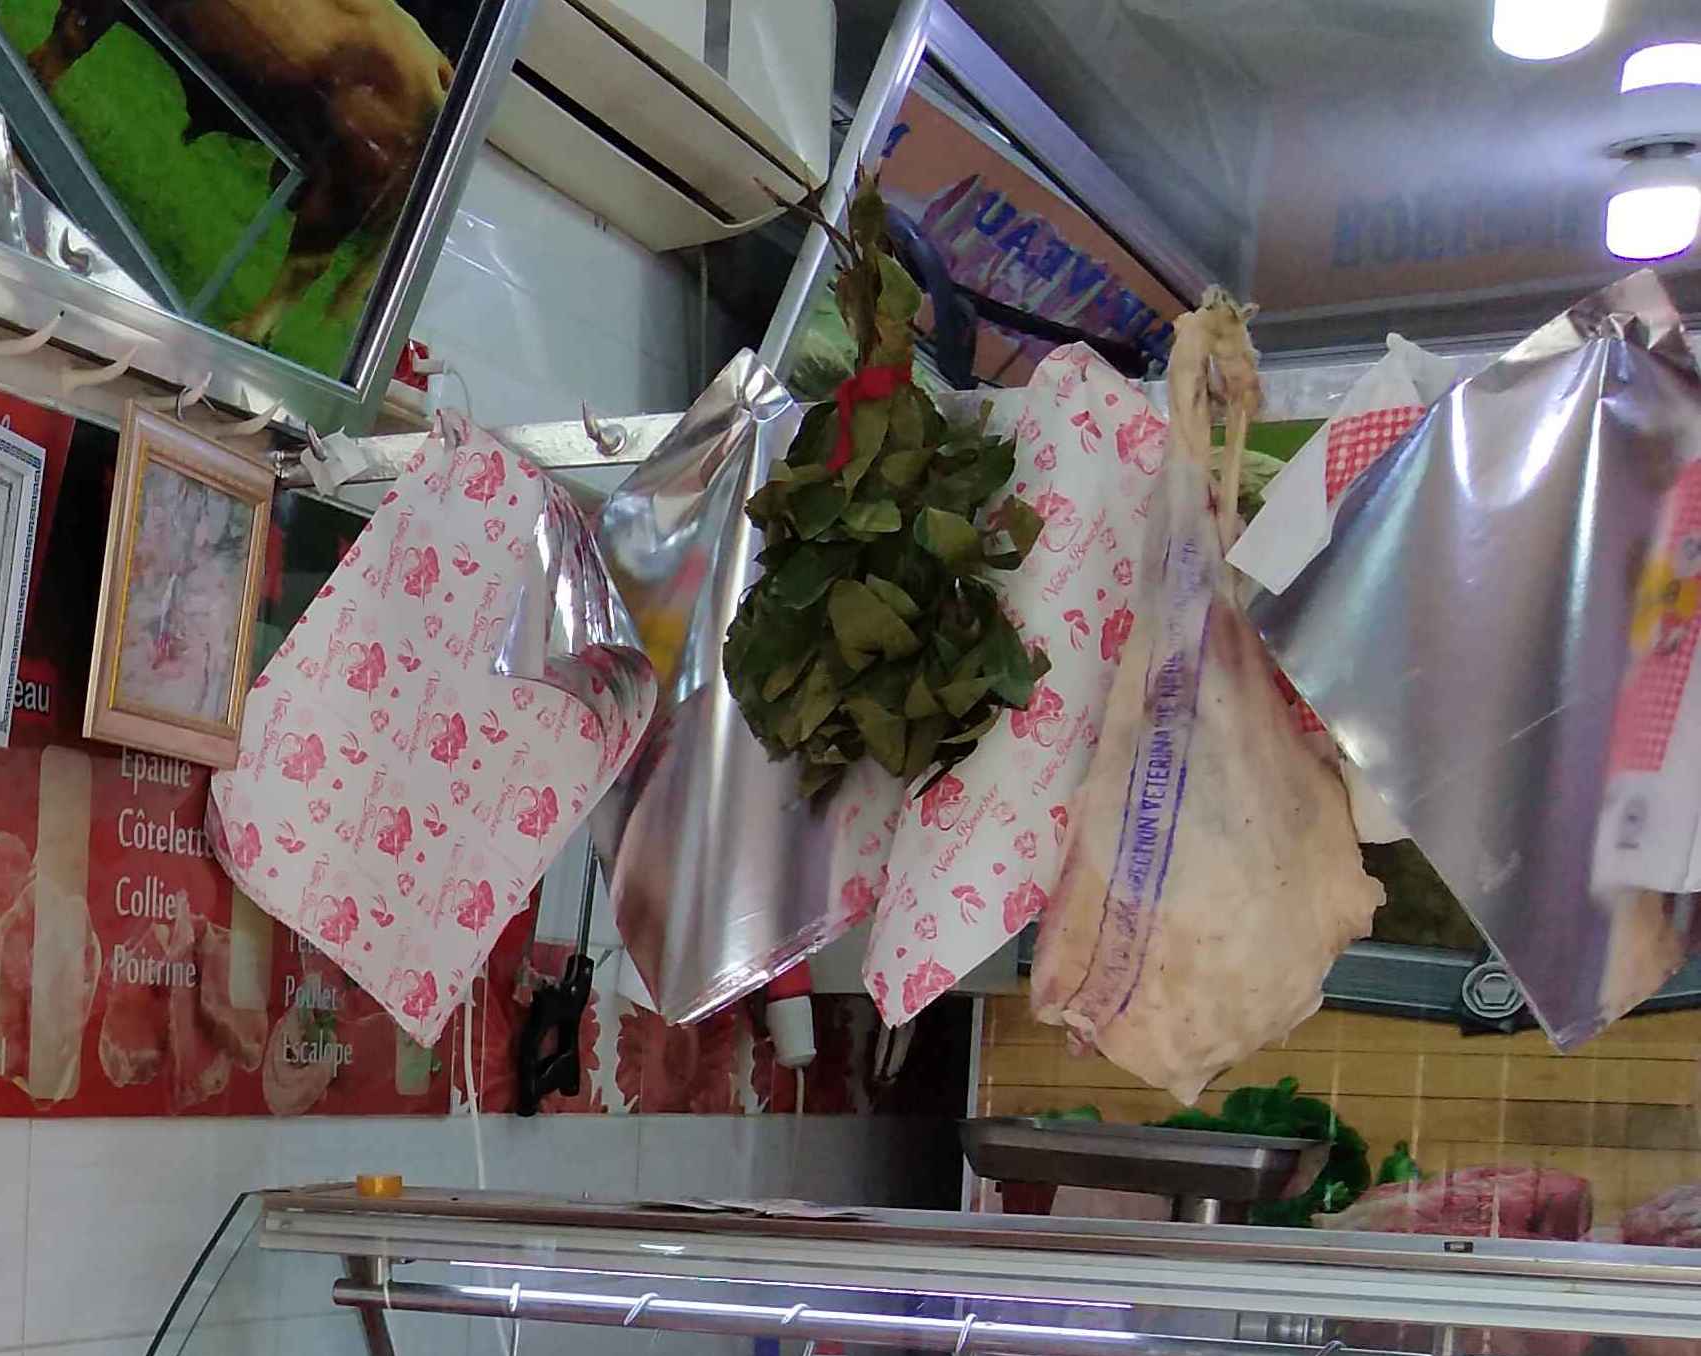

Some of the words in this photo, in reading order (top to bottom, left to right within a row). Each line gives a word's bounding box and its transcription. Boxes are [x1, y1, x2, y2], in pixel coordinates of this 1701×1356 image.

[12, 679, 51, 714] eau
[112, 944, 196, 988] Poitrine
[282, 1030, 353, 1077] Escalope
